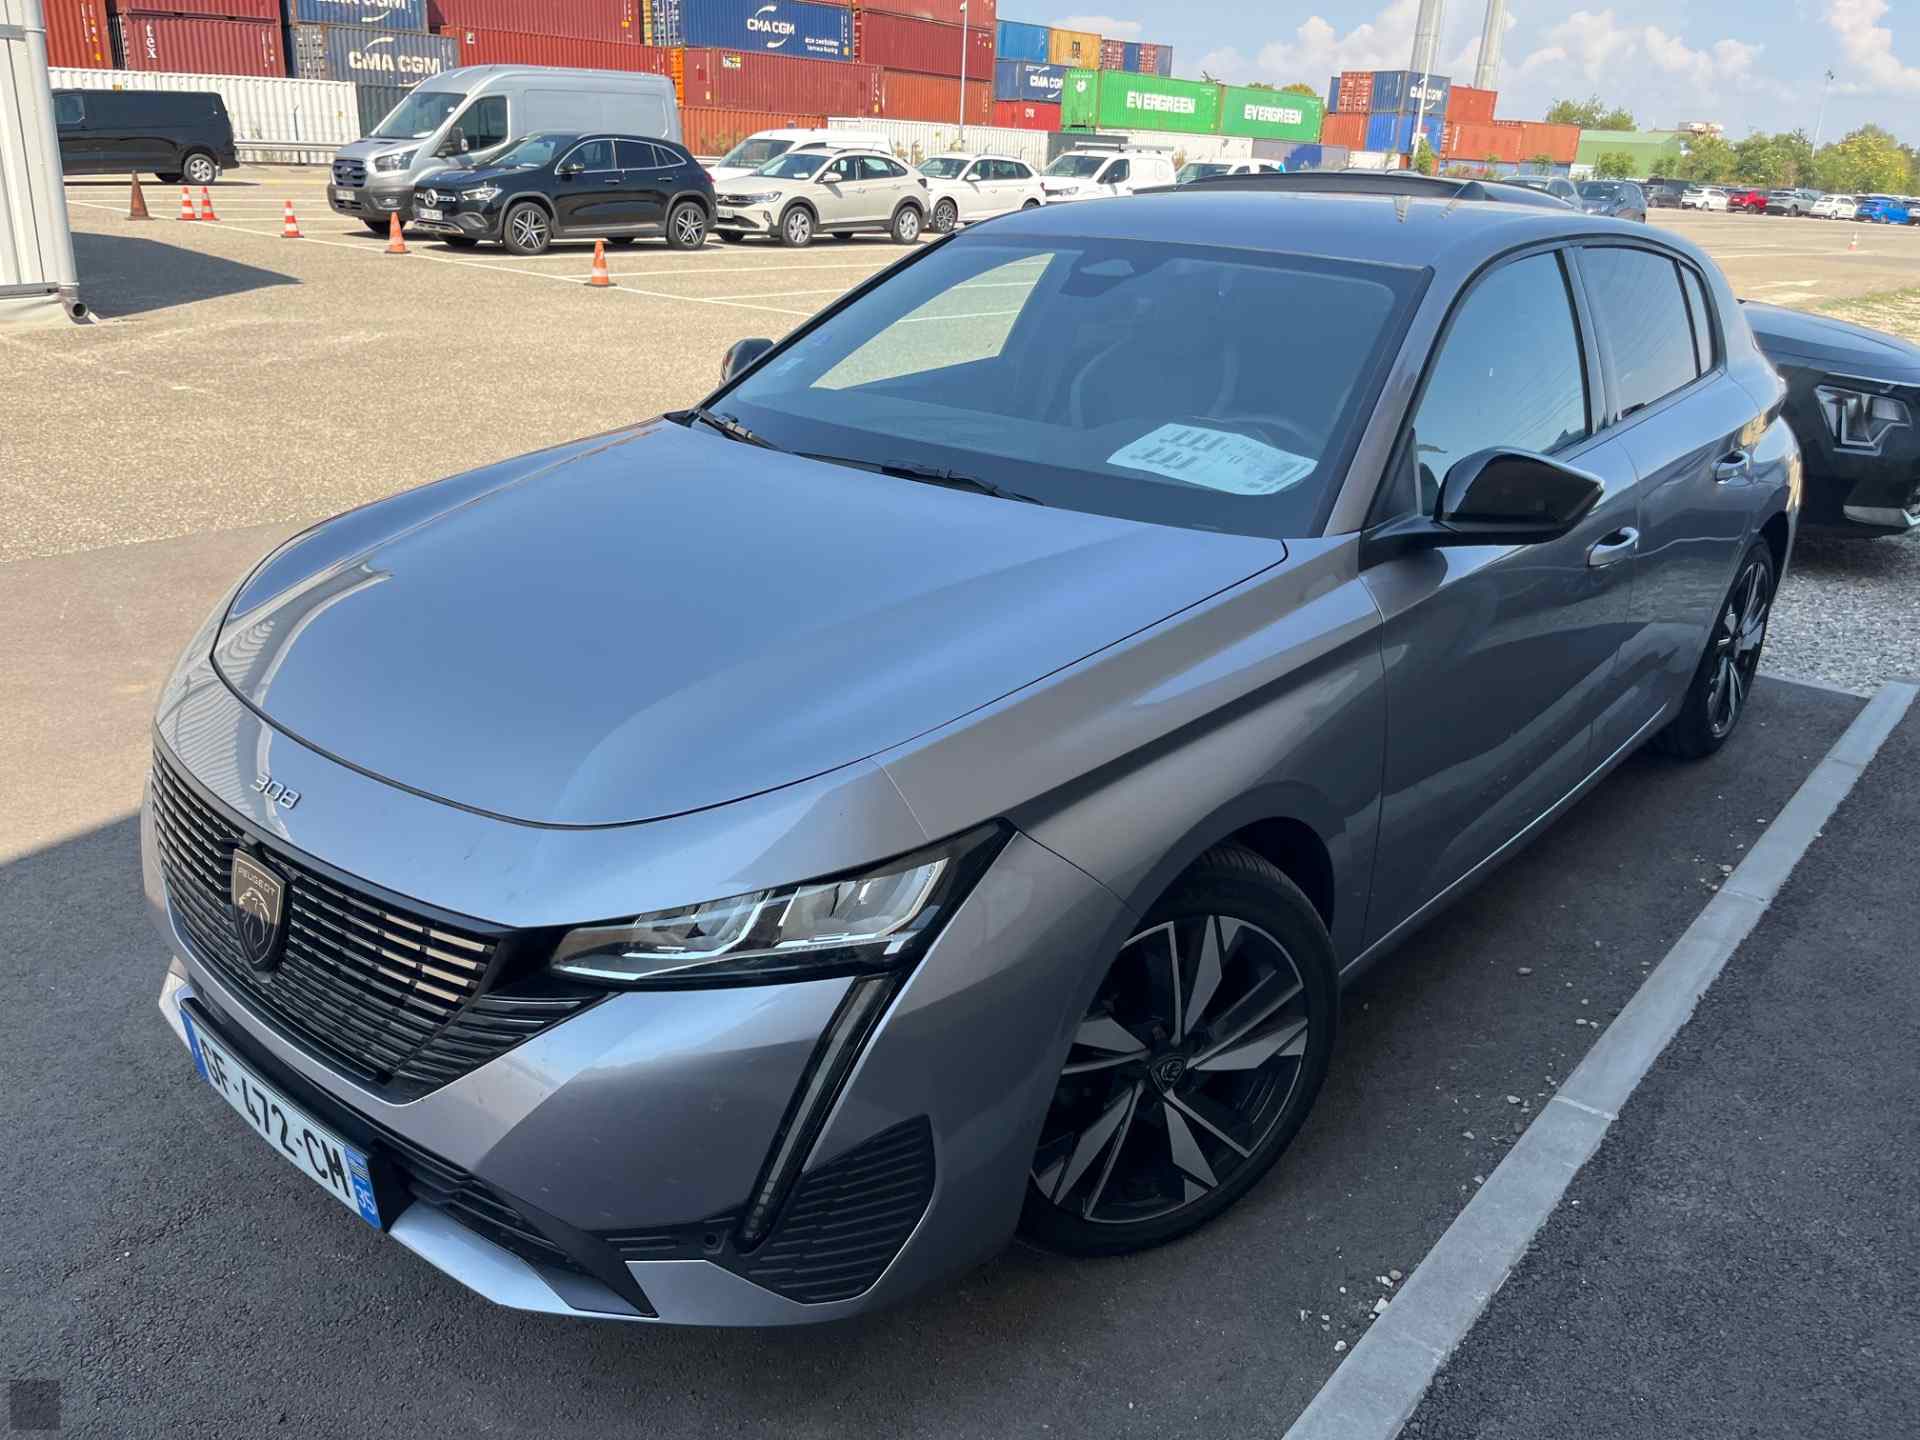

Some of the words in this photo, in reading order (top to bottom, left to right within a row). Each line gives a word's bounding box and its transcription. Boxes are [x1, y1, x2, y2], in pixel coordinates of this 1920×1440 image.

[747, 18, 771, 32] CMA
[772, 22, 795, 35] CGM
[147, 24, 157, 58] tex
[349, 51, 395, 71] CMA
[397, 55, 441, 75] CGM
[1126, 90, 1196, 114] EVERGREEN
[1244, 103, 1302, 125] EVERGREEN
[249, 774, 301, 810] 308
